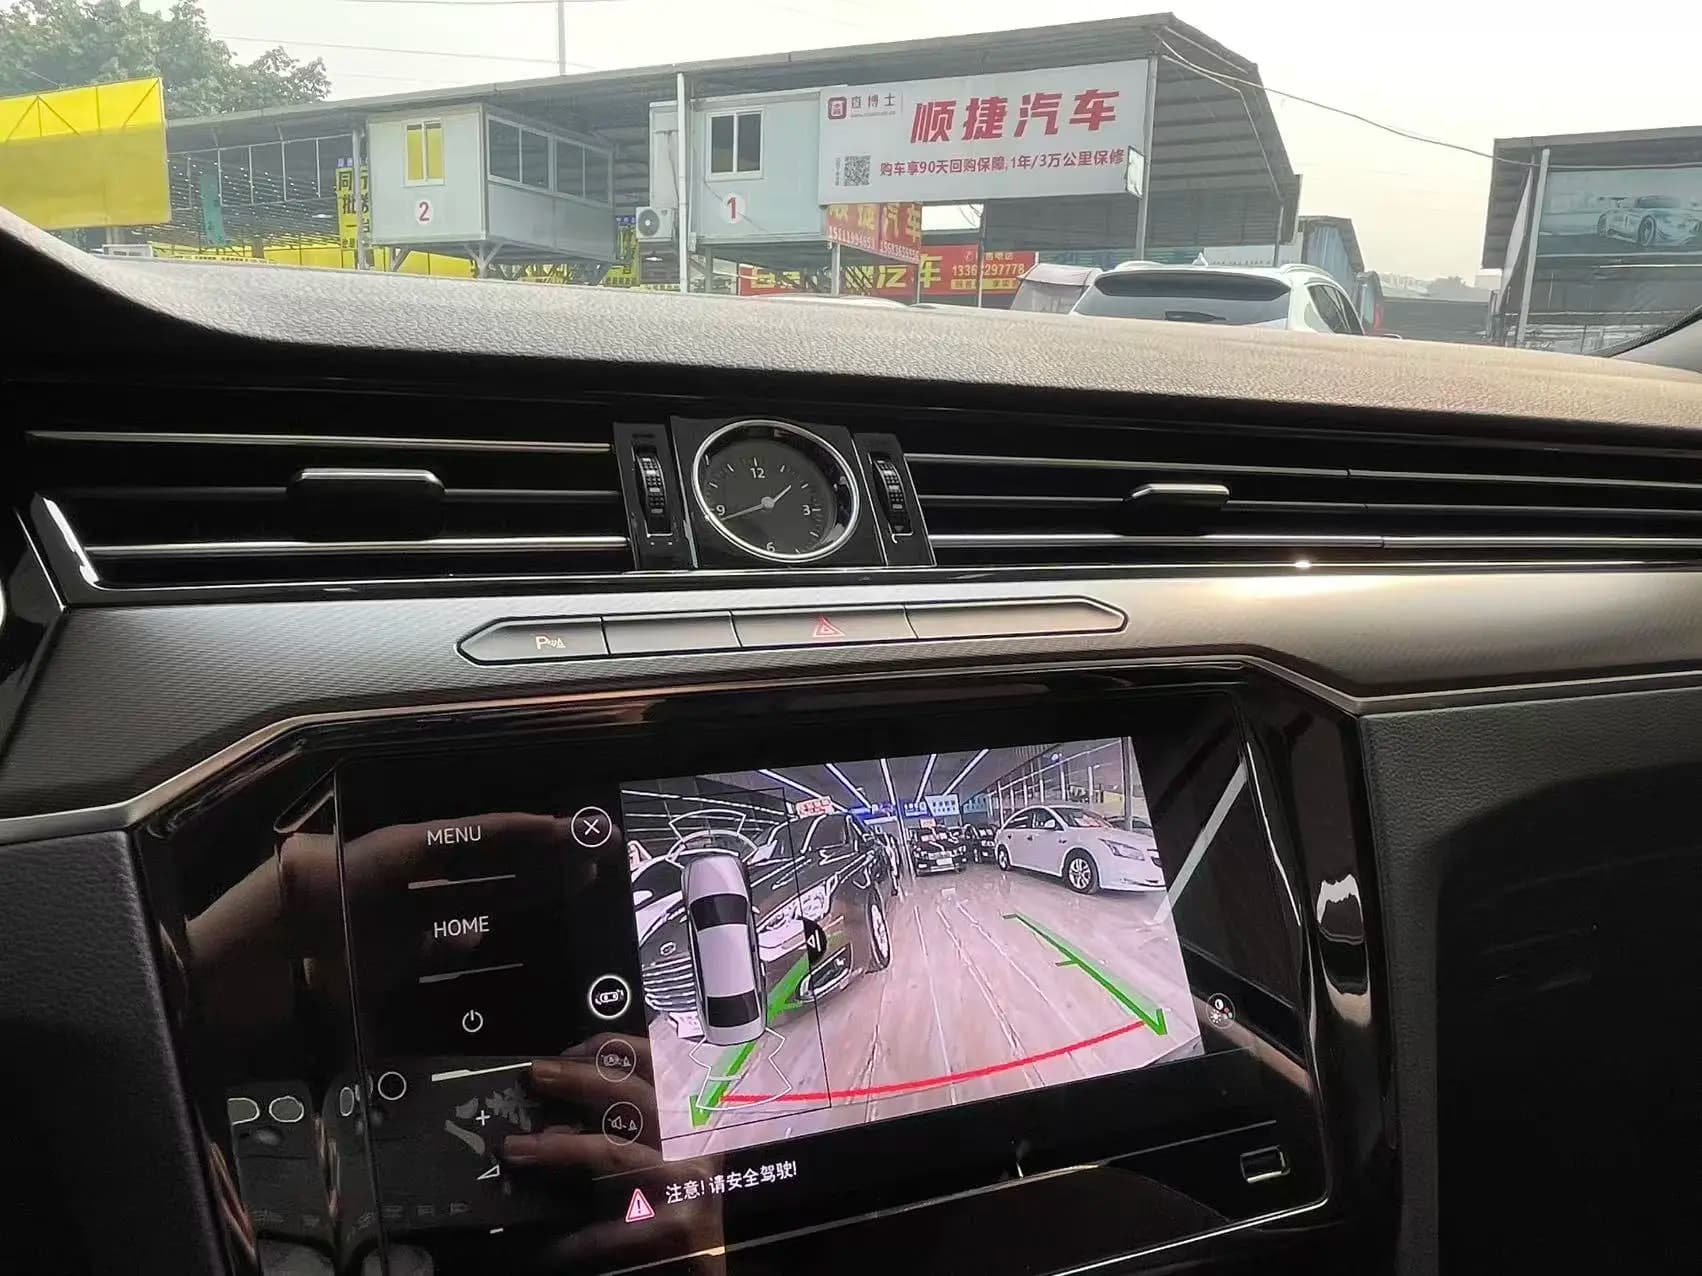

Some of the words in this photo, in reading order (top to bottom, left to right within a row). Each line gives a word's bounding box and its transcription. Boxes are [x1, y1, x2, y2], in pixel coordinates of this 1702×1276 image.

[911, 89, 1120, 143] 顺捷汽车
[420, 202, 430, 221] 2
[728, 197, 737, 219] 1
[952, 263, 1025, 276] 1336297778
[751, 468, 765, 479] 12
[716, 504, 726, 515] 9
[802, 505, 811, 516] 3
[766, 541, 775, 553] 6
[427, 826, 482, 846] MENU
[434, 915, 490, 938] HOME
